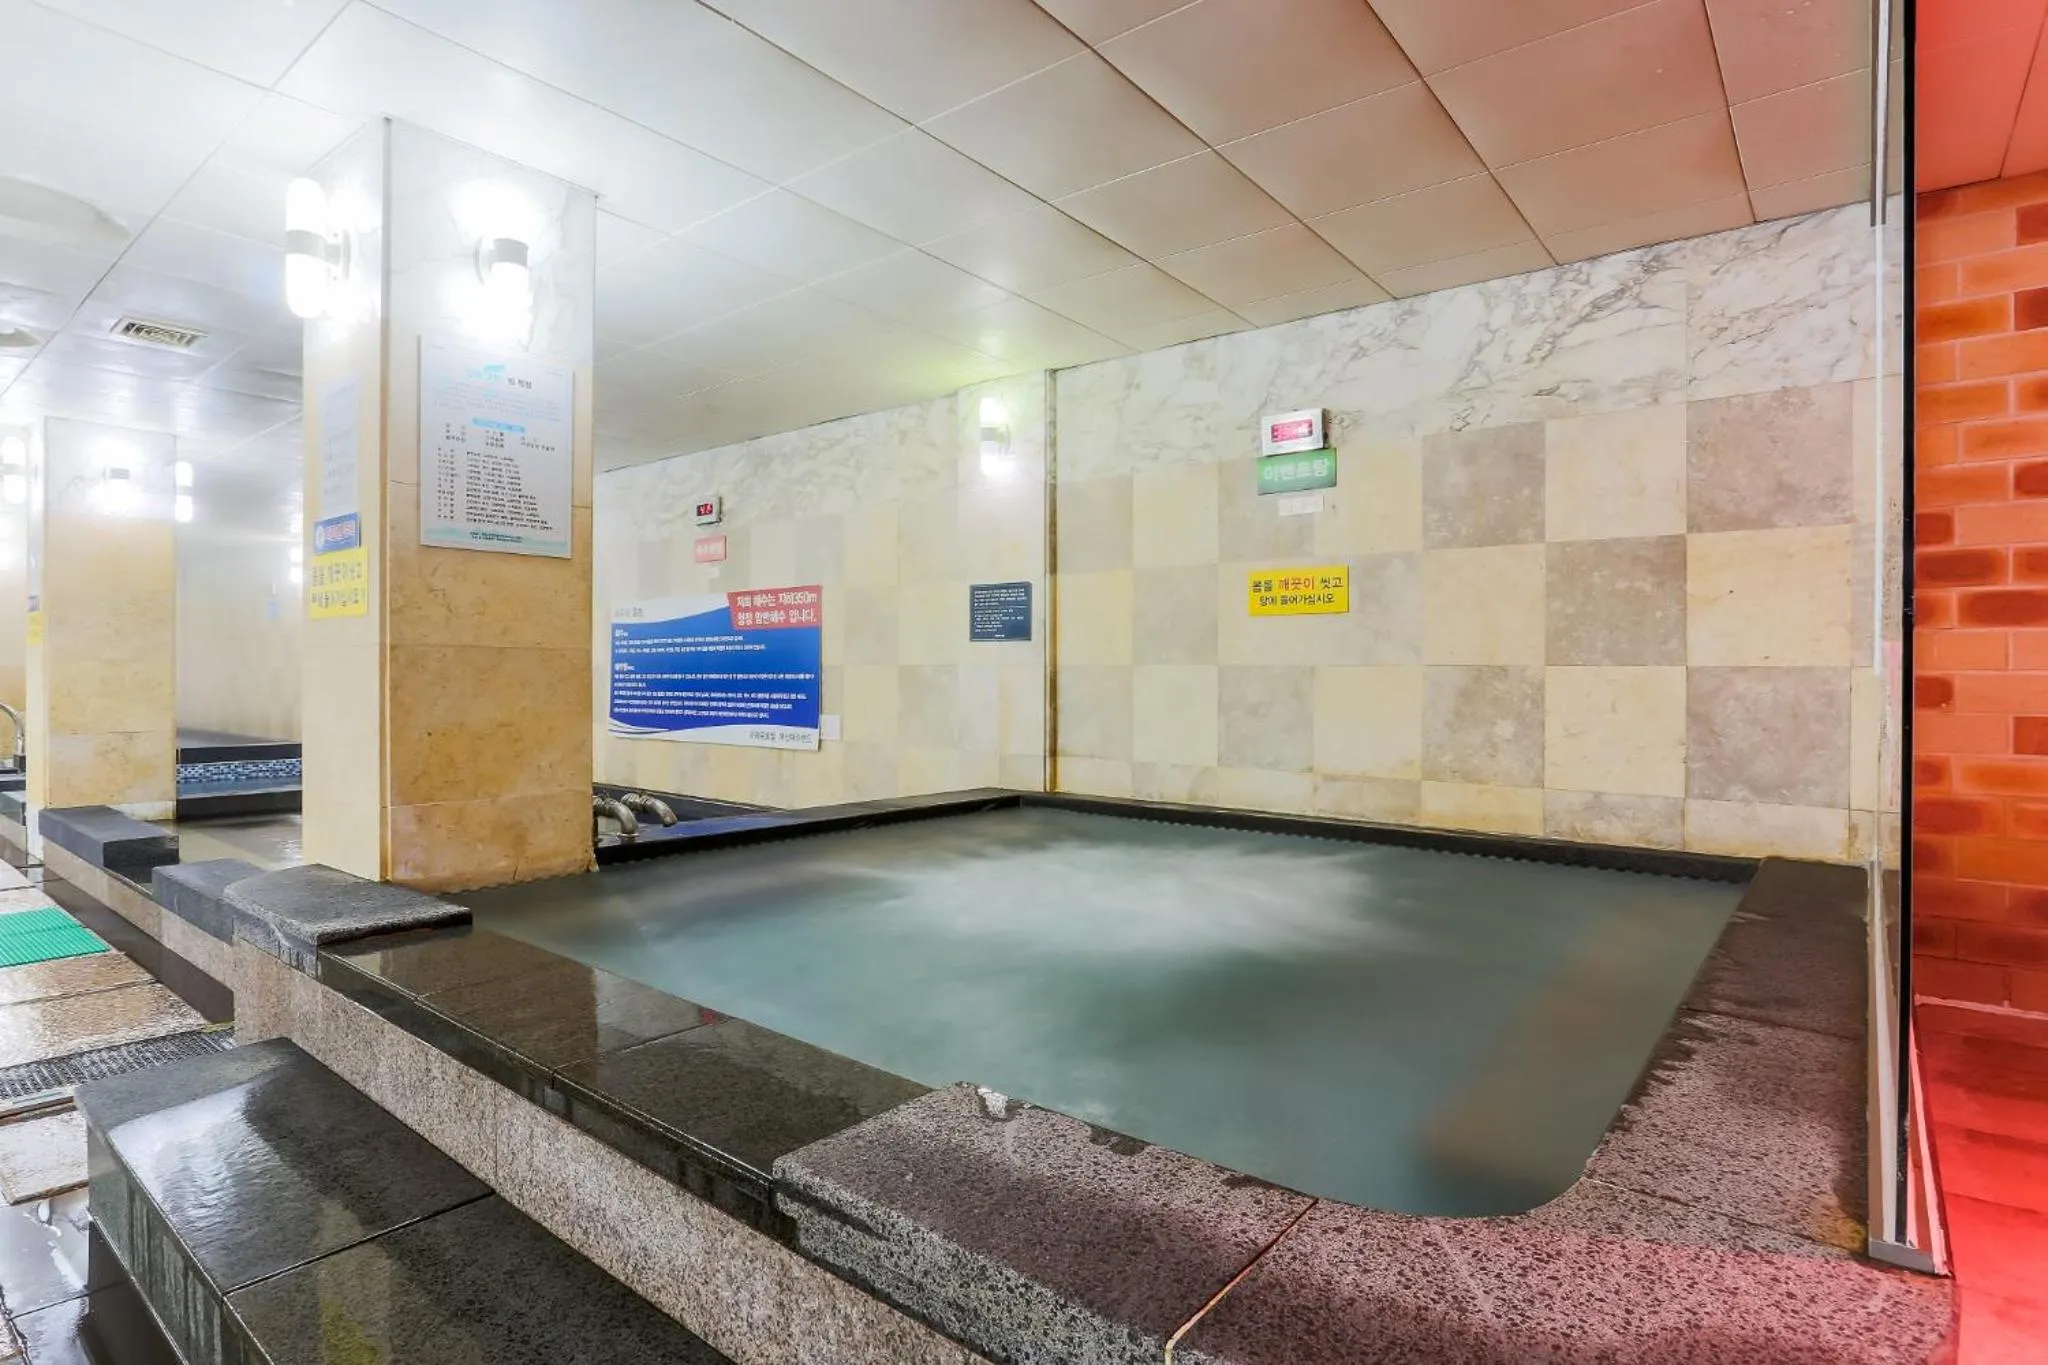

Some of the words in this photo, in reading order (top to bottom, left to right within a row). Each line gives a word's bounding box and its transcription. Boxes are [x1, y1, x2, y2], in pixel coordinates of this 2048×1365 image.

[1252, 579, 1273, 593] 몸을
[1277, 575, 1315, 591] 깨끗이
[1320, 576, 1344, 589] 씻고
[1280, 593, 1335, 605] 들어가십시오
